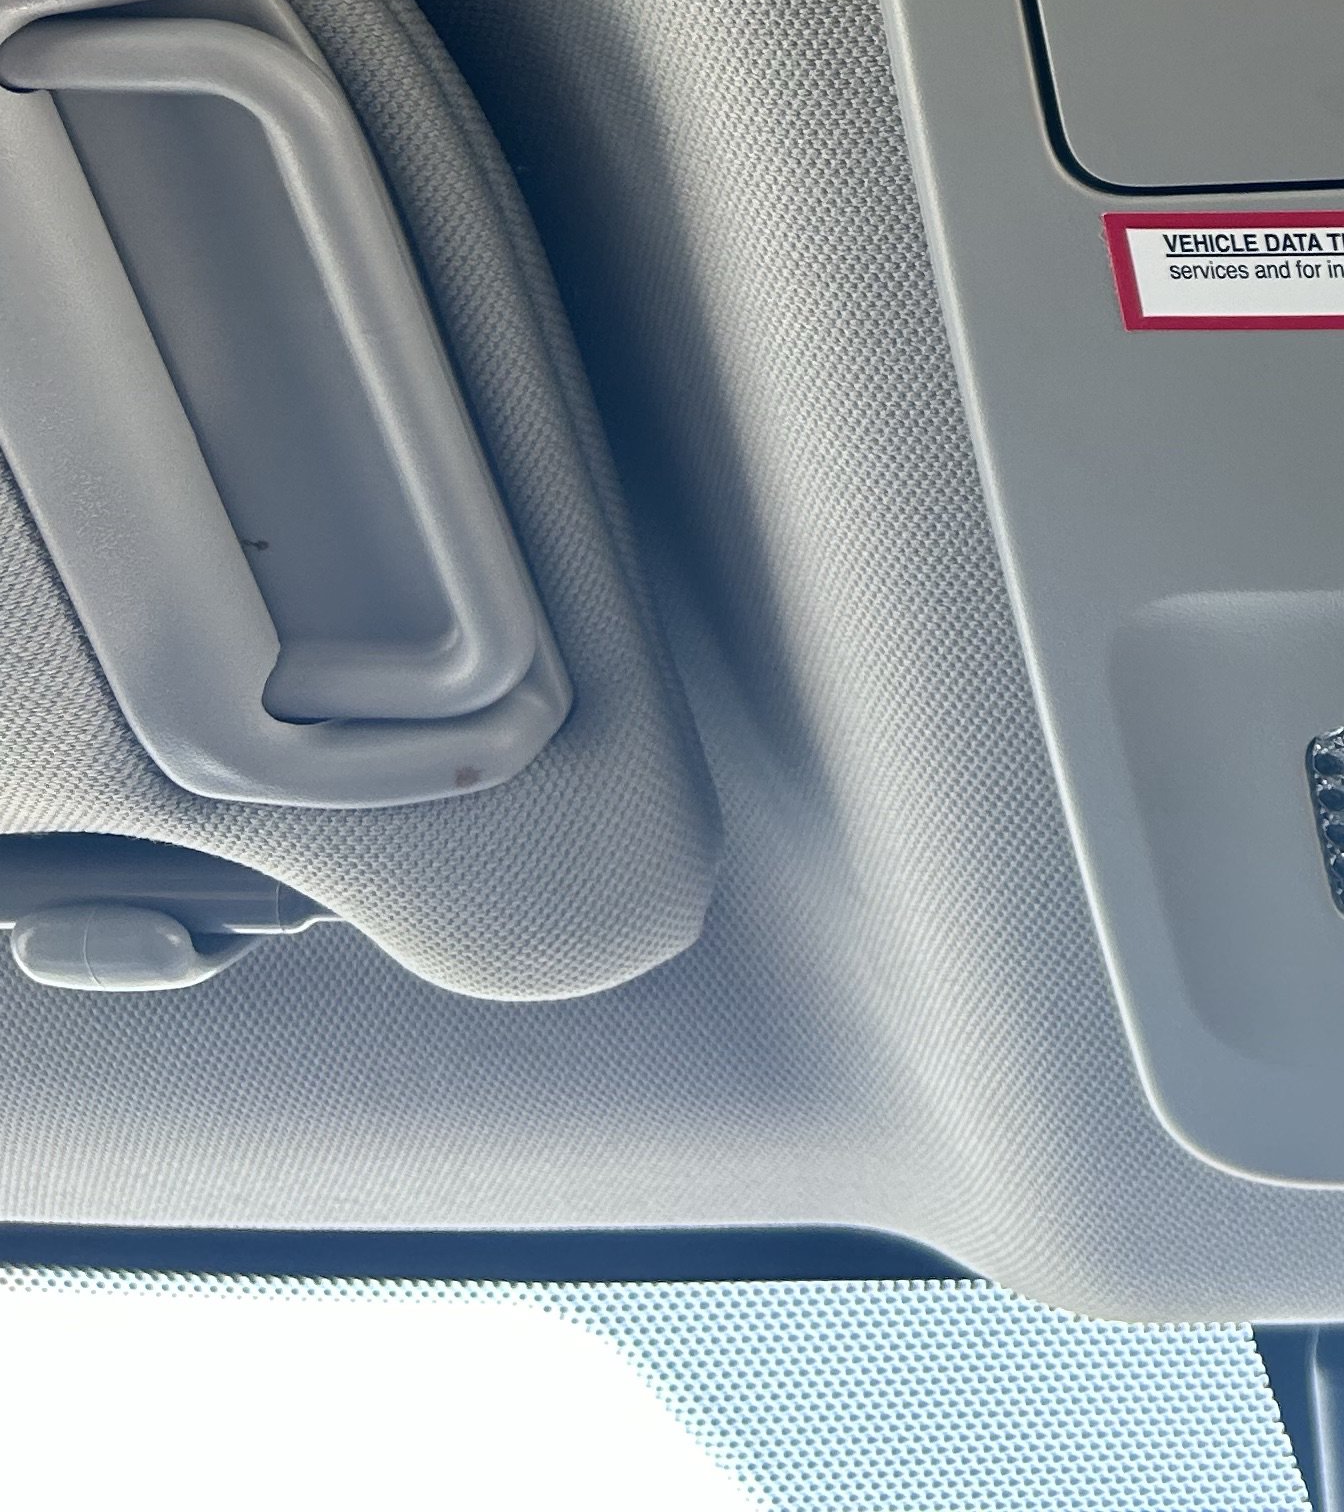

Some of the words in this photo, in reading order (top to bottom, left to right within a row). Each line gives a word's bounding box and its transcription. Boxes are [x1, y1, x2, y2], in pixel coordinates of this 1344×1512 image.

[1163, 234, 1259, 254] VEHICLE
[1265, 232, 1323, 252] DATA
[1170, 261, 1249, 280] services
[1255, 259, 1291, 279] and
[1295, 259, 1321, 278] for
